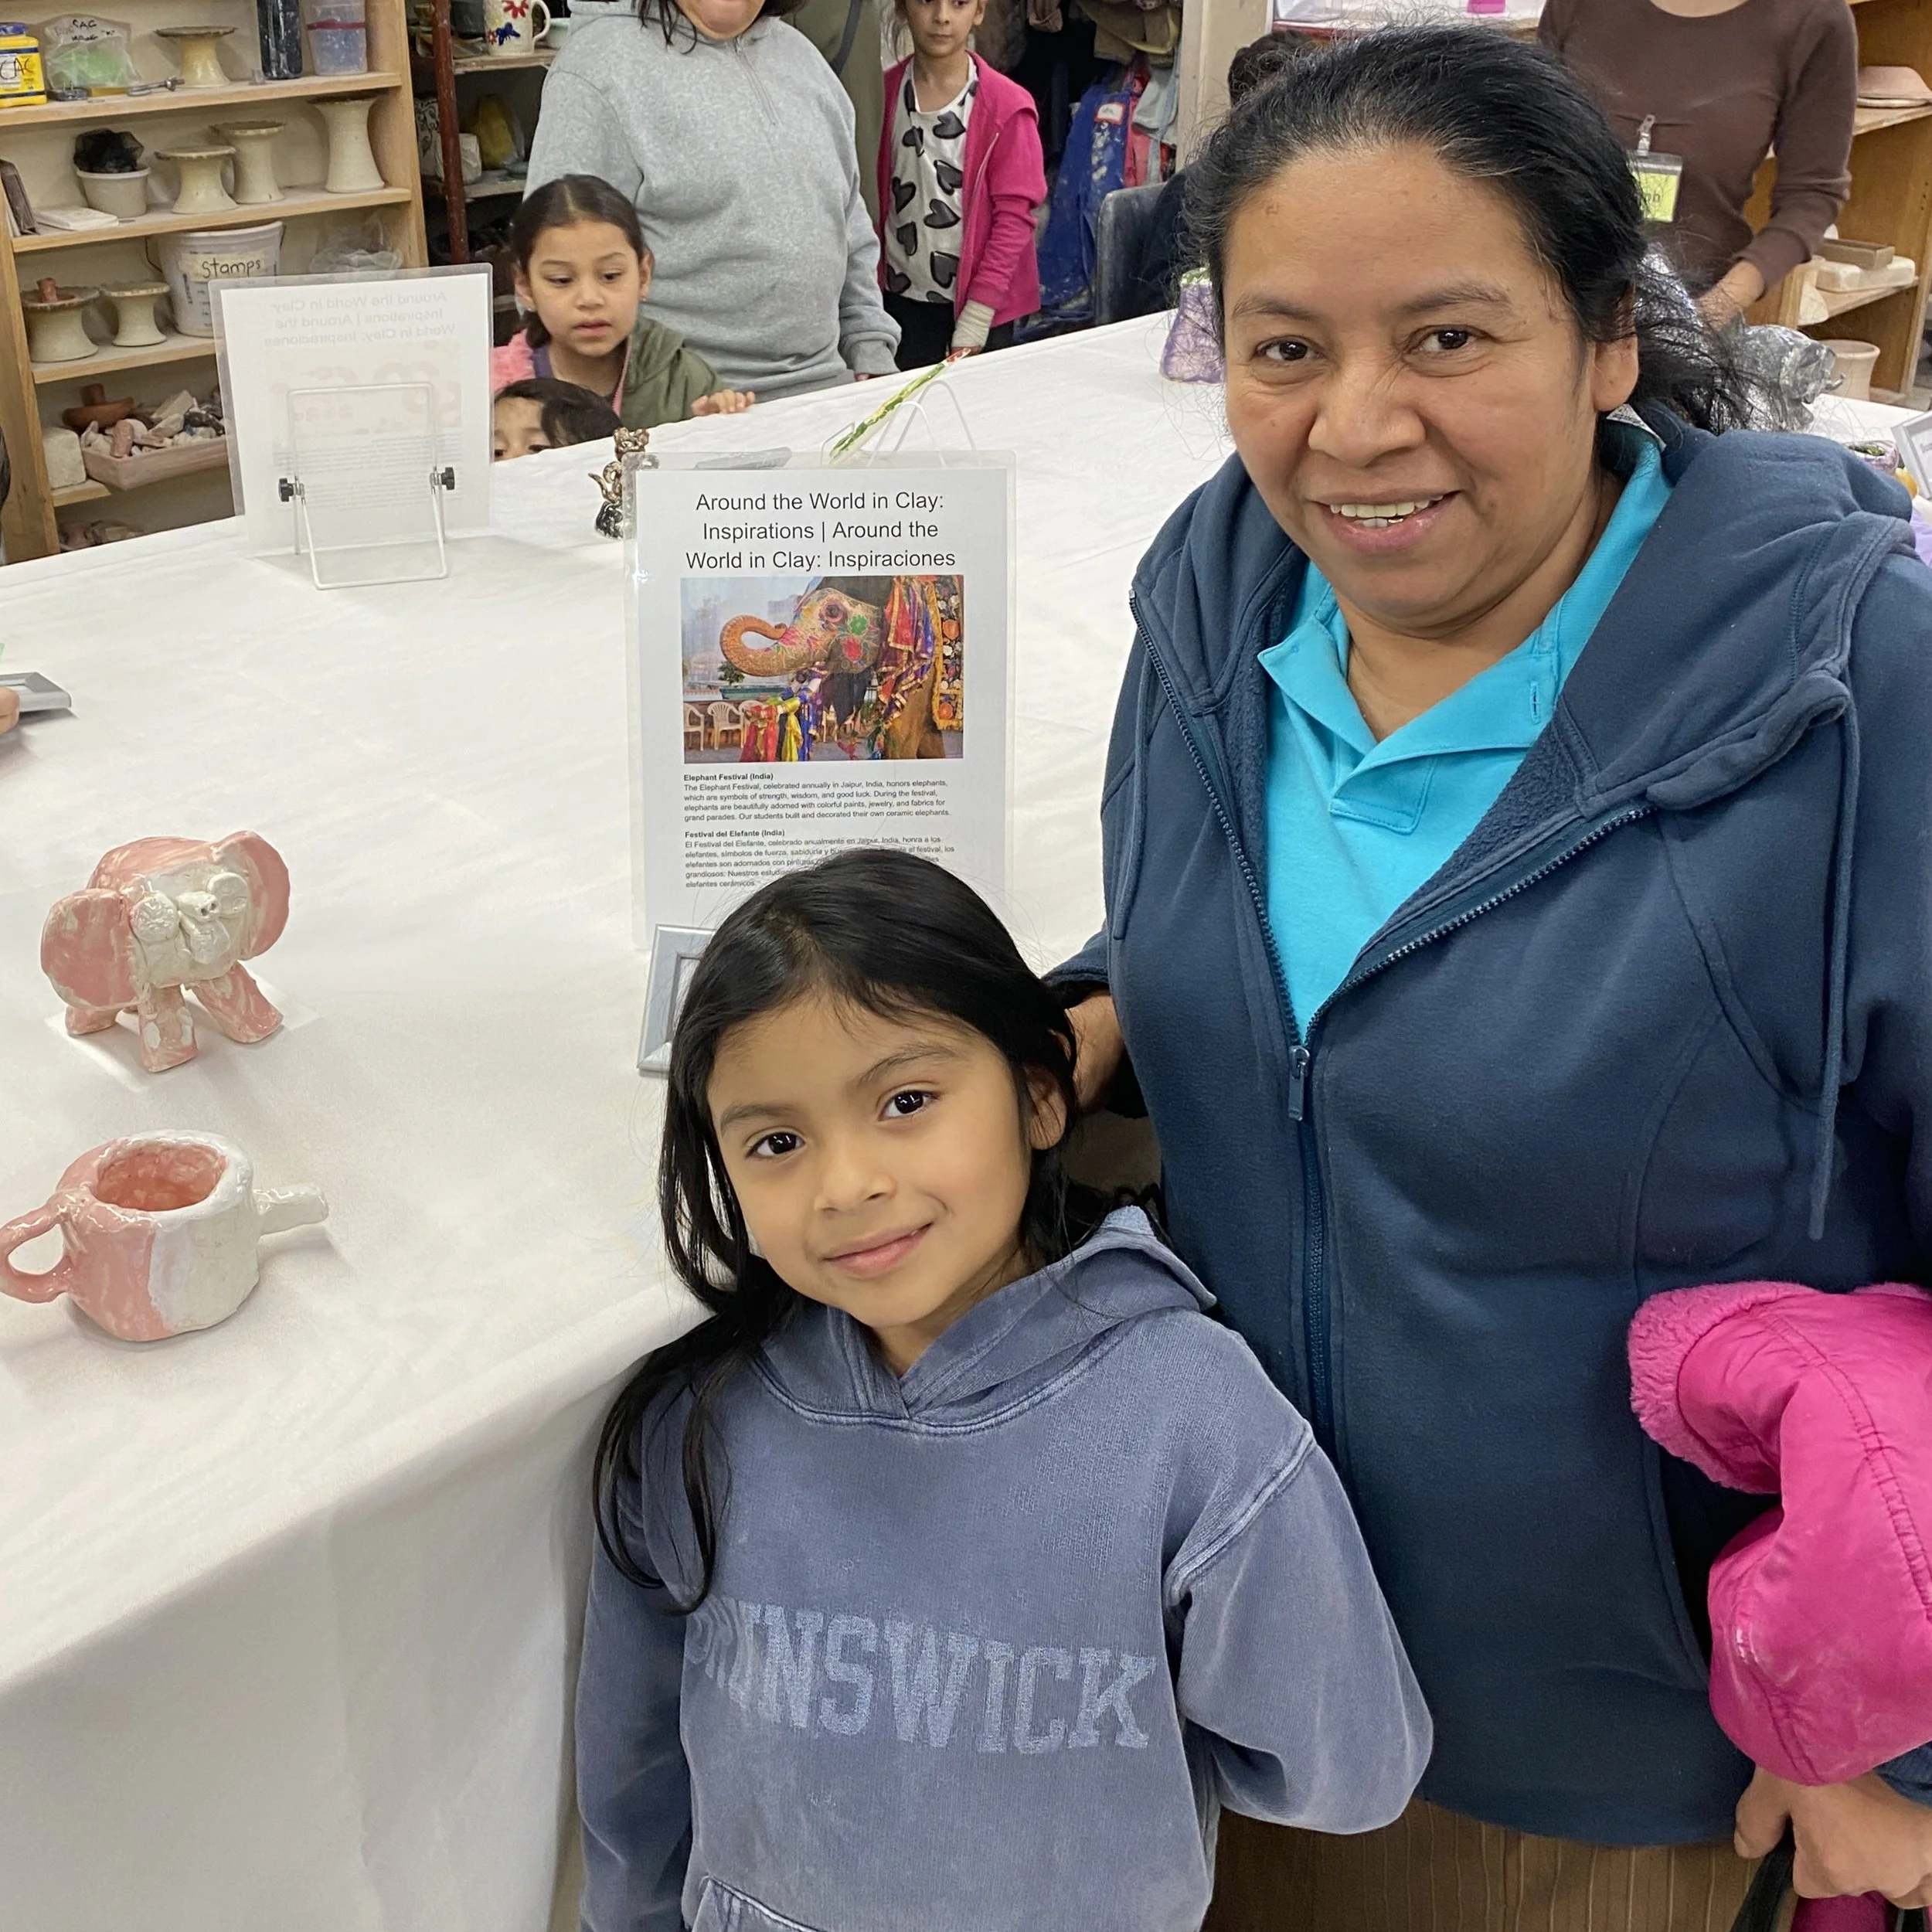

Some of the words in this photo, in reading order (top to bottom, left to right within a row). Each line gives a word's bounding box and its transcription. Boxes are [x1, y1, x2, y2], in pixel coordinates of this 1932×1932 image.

[202, 257, 261, 278] Stamps
[696, 493, 766, 510] Around
[773, 493, 802, 510] the
[809, 492, 865, 509] World
[872, 492, 888, 509] in
[896, 492, 944, 512] Clay:
[704, 522, 815, 543] Inspirations
[832, 521, 902, 538] Around
[909, 520, 938, 538] the
[686, 552, 742, 569] World
[750, 551, 765, 568] in
[773, 551, 821, 572] Clay:
[829, 549, 956, 571] Inspiraciones
[699, 784, 731, 793] Elephant
[912, 780, 948, 788] elephants,
[719, 793, 748, 802] symbols
[758, 792, 789, 801] strength,
[836, 791, 854, 799] good
[873, 790, 897, 798] During
[684, 804, 718, 812] elephants
[733, 802, 768, 811] beautifully
[844, 801, 867, 809] paints,
[869, 800, 894, 809] jewelry,
[684, 813, 705, 822] grand
[706, 813, 736, 821] parades.
[915, 809, 951, 818] elephants.
[804, 838, 845, 846] anualmente
